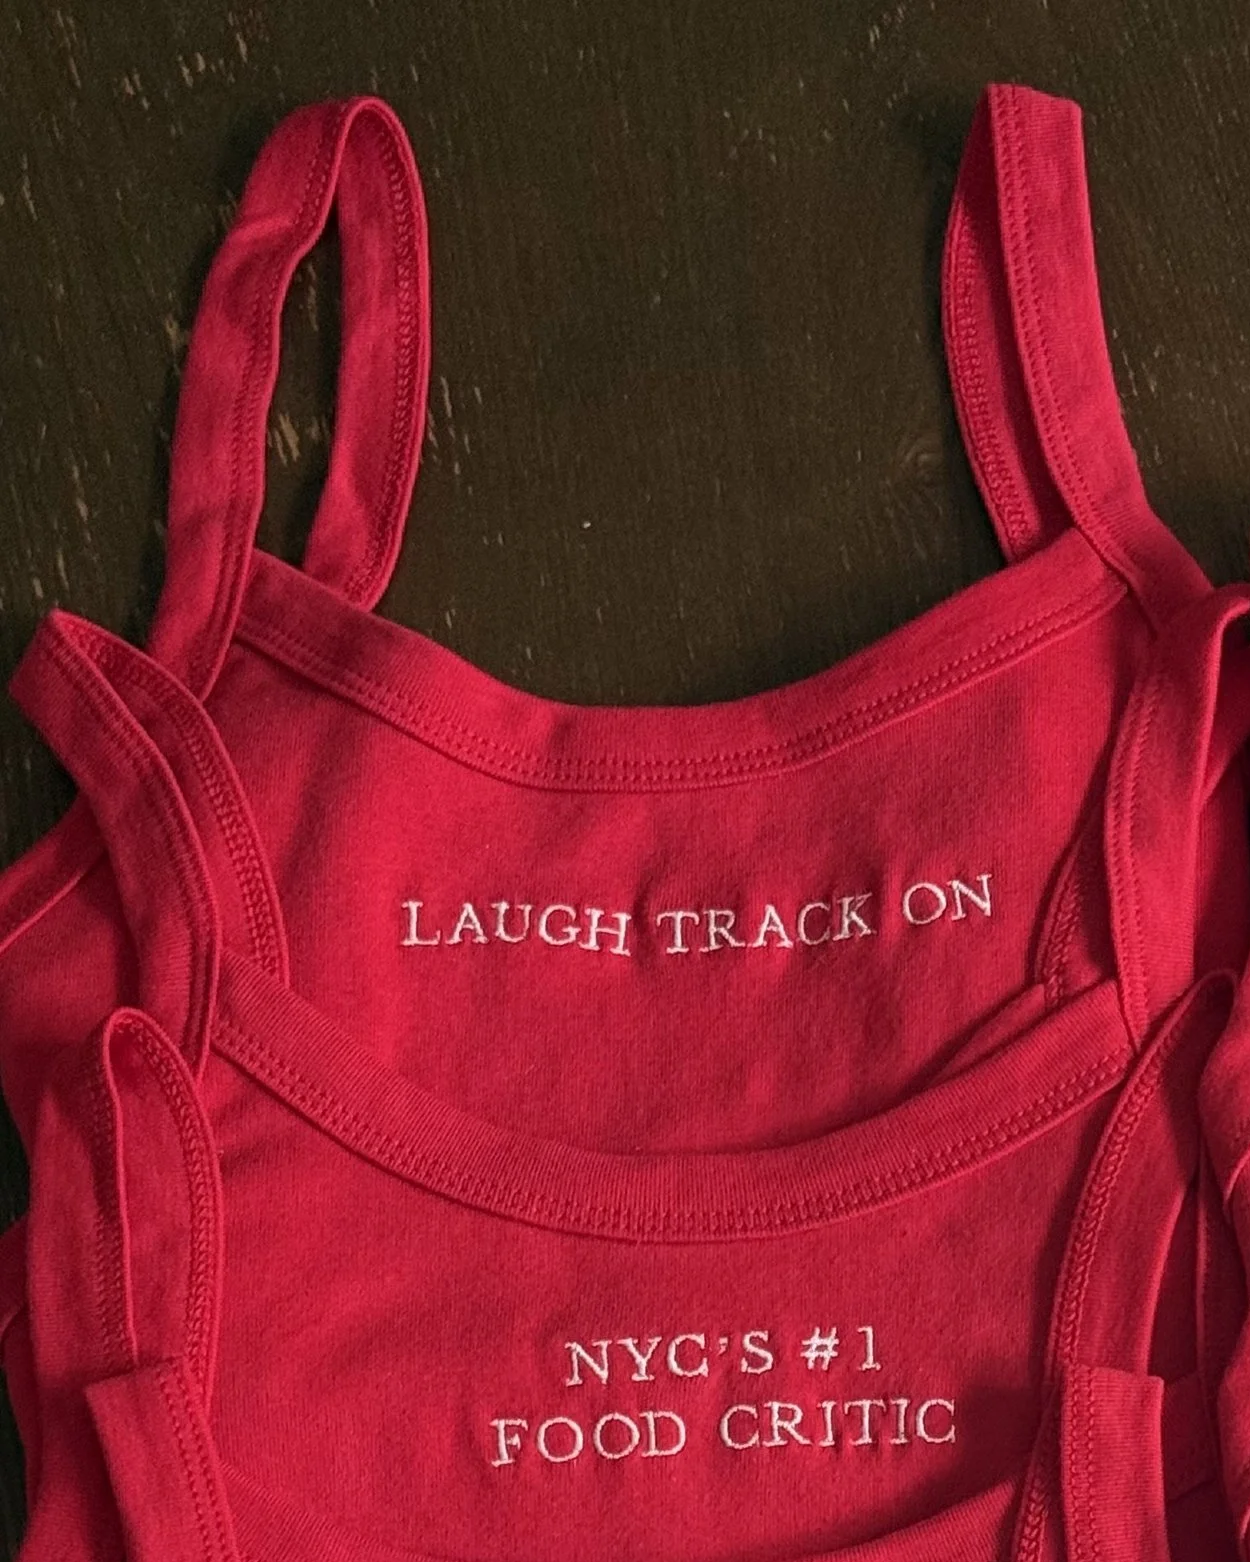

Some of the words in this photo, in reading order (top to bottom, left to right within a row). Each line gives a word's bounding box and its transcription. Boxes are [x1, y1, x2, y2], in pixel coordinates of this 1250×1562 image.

[402, 900, 633, 957] LAUGH
[656, 897, 875, 954] TRACK
[903, 873, 994, 925] ON
[800, 1326, 882, 1371] #1
[489, 1410, 687, 1469] FOOD
[720, 1398, 957, 1451] CRITIC
